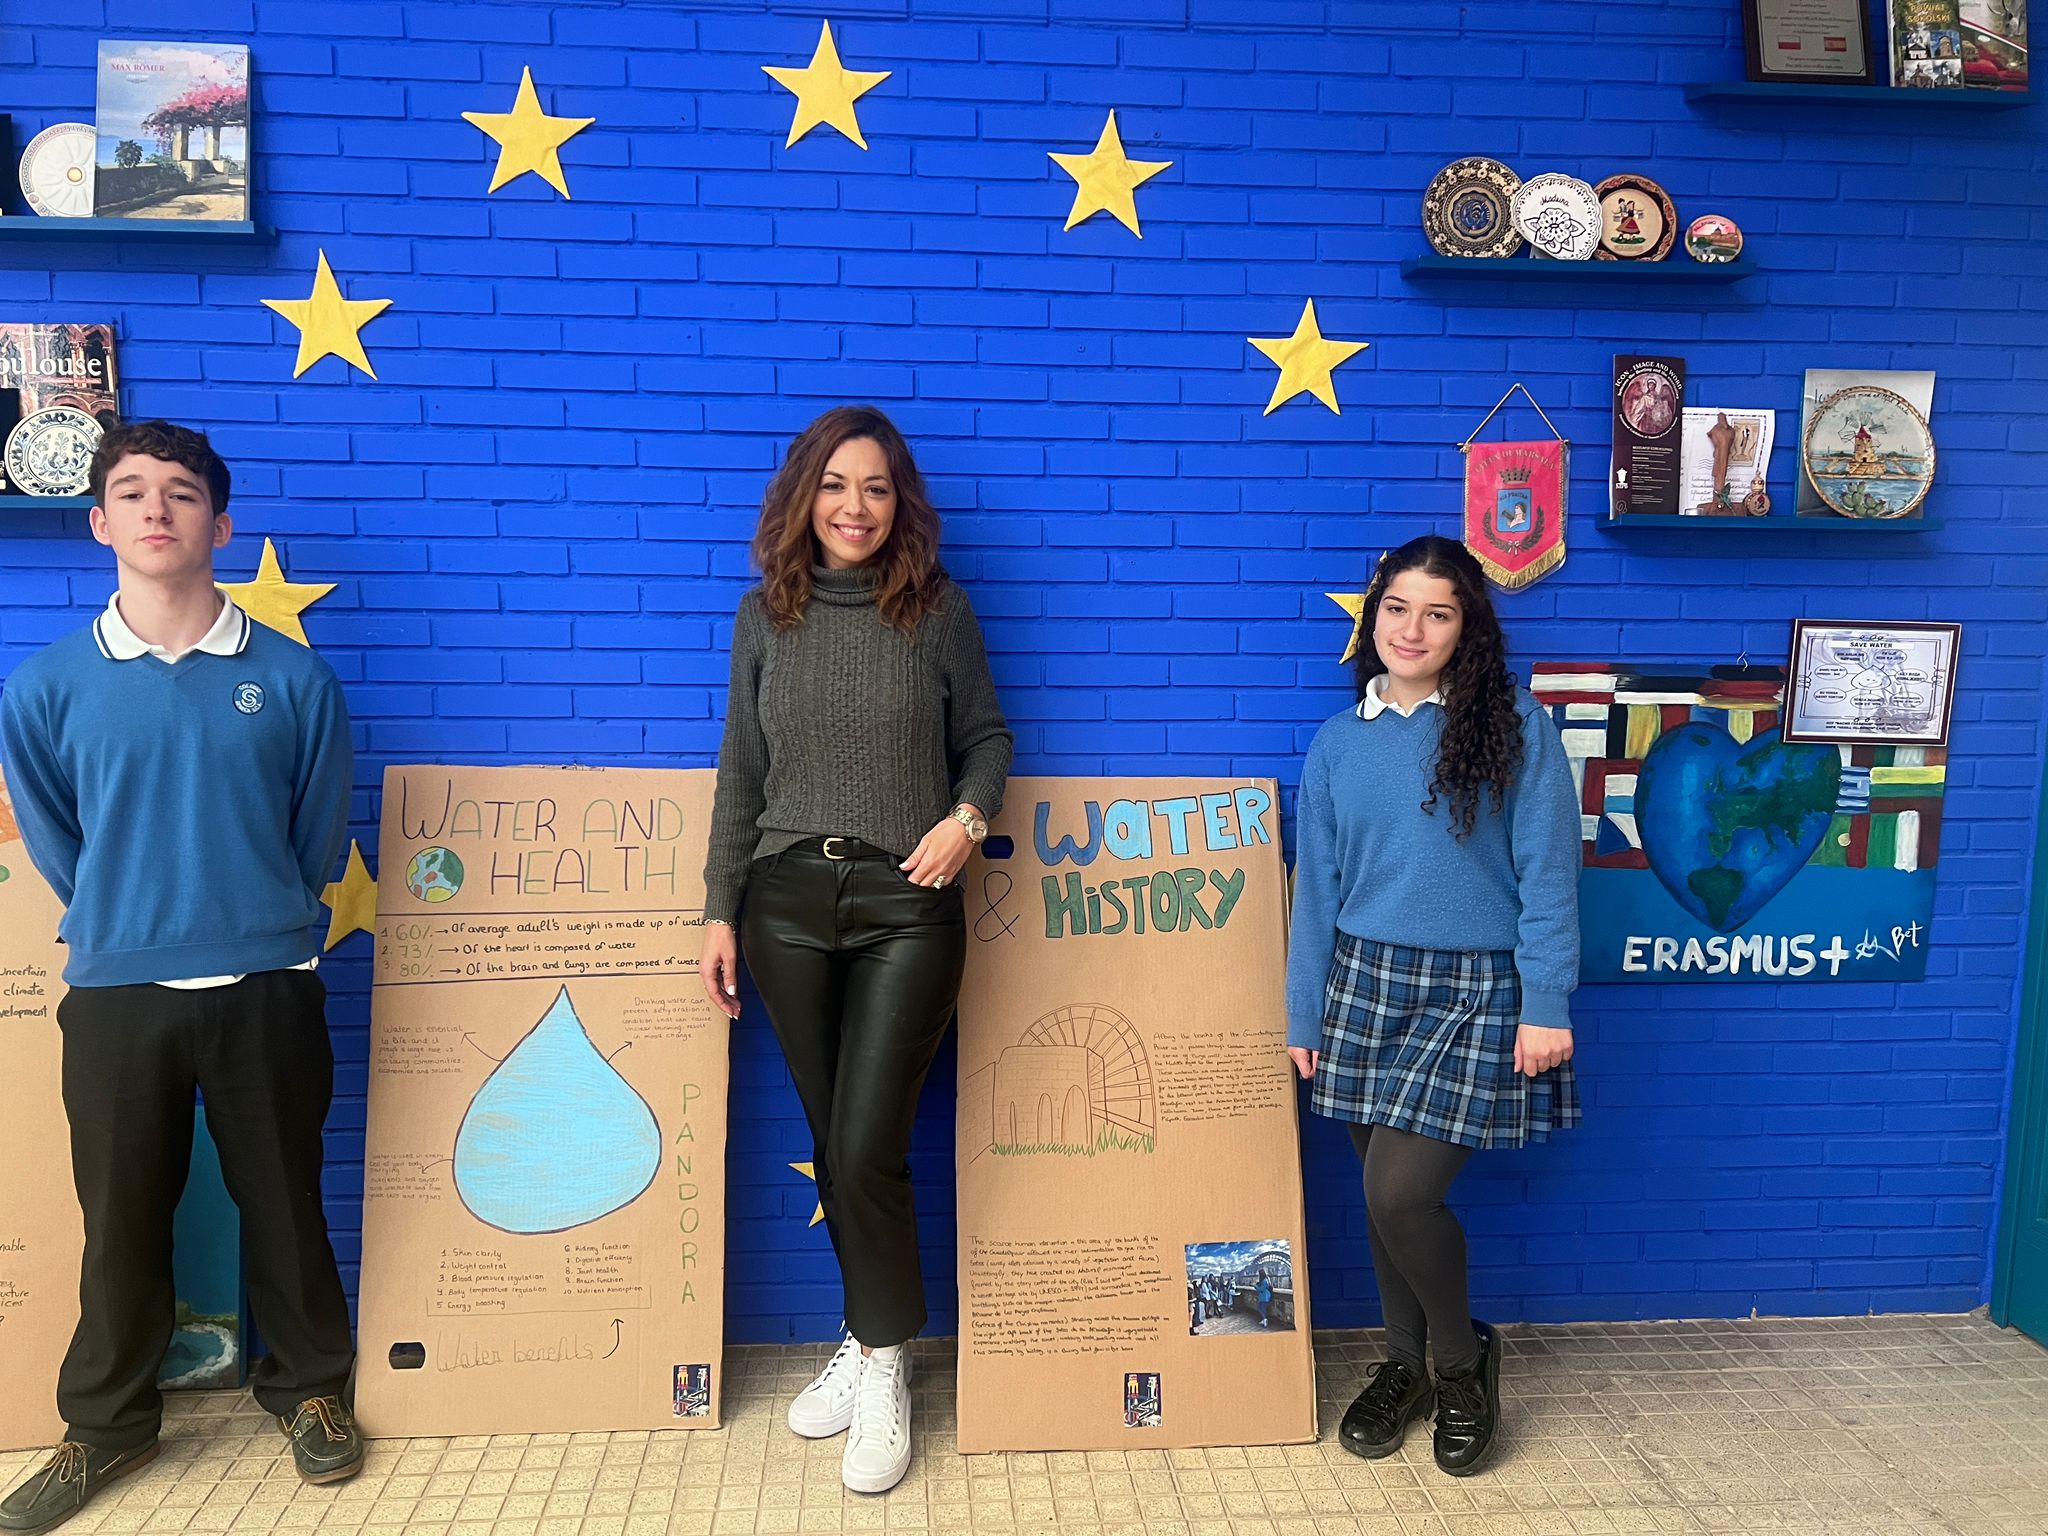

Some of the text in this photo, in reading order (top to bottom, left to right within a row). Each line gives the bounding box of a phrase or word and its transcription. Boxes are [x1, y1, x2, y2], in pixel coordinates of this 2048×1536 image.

[1632, 361, 1655, 370] IMAGE
[1656, 362, 1669, 371] AND
[1669, 369, 1682, 389] WORD
[403, 776, 683, 842] WATER AND
[492, 846, 675, 895] HEALTH
[974, 870, 1020, 942] &
[467, 924, 510, 938] average
[616, 919, 645, 928] made
[650, 920, 663, 931] up
[668, 916, 680, 926] of
[462, 944, 478, 954] Of
[484, 944, 501, 953] the
[533, 942, 541, 951] is
[544, 942, 591, 954] composed
[595, 941, 606, 951] of
[608, 942, 636, 950] water
[1622, 934, 1850, 976] ERASMUS+
[466, 963, 481, 976] Of
[486, 963, 503, 973] the
[510, 961, 538, 972] brain
[542, 960, 560, 969] and
[564, 960, 590, 974] lungs
[595, 960, 610, 968] are
[615, 959, 660, 969] composed
[664, 956, 676, 966] of
[3, 982, 45, 996] climate
[634, 997, 665, 1008] Drinking
[676, 1084, 701, 1304] PANDORA
[967, 1236, 984, 1245] The
[453, 1248, 472, 1256] Skin
[451, 1274, 473, 1282] Blood
[475, 1276, 504, 1284] pressure
[508, 1274, 544, 1285] regulation
[448, 1289, 465, 1298] Body
[447, 1302, 471, 1312] Energy
[436, 1330, 504, 1373] Water
